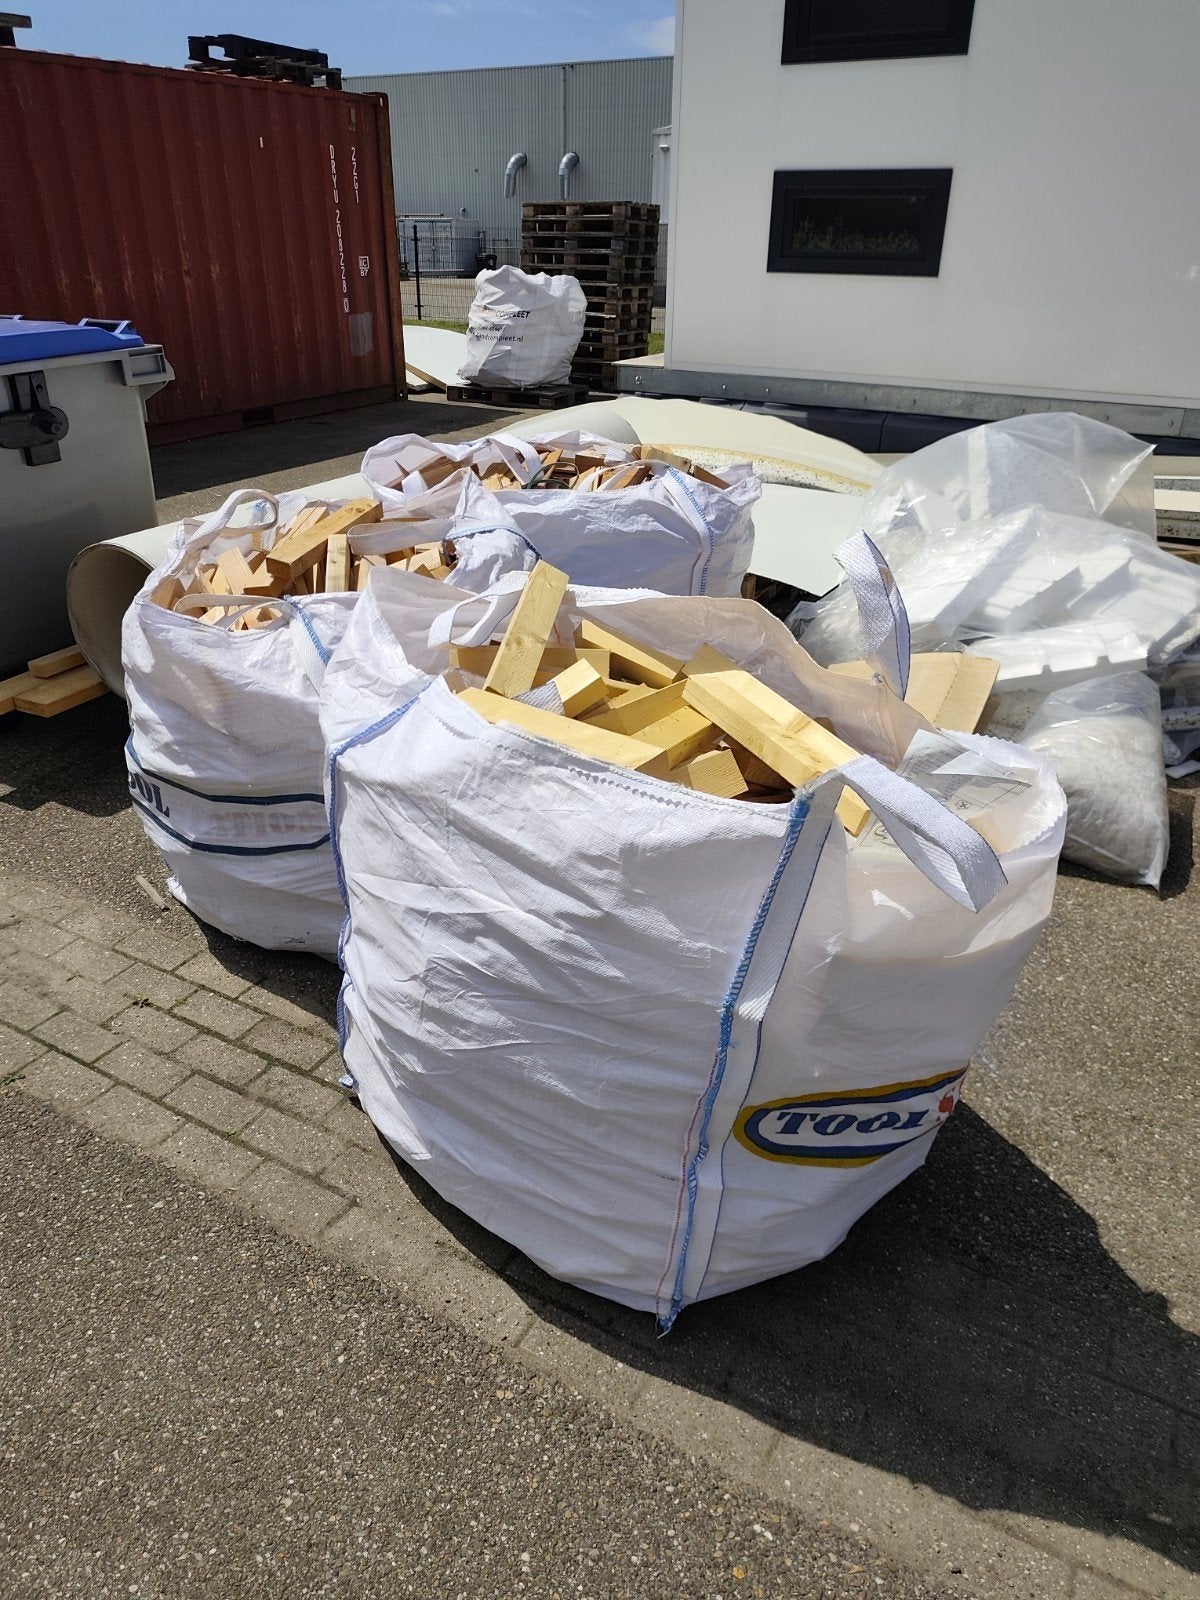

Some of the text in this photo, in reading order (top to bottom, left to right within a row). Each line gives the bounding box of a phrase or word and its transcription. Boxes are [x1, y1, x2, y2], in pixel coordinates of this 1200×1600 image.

[329, 144, 339, 204] DRYU
[335, 209, 347, 293] 208228
[351, 146, 359, 204] 22G1
